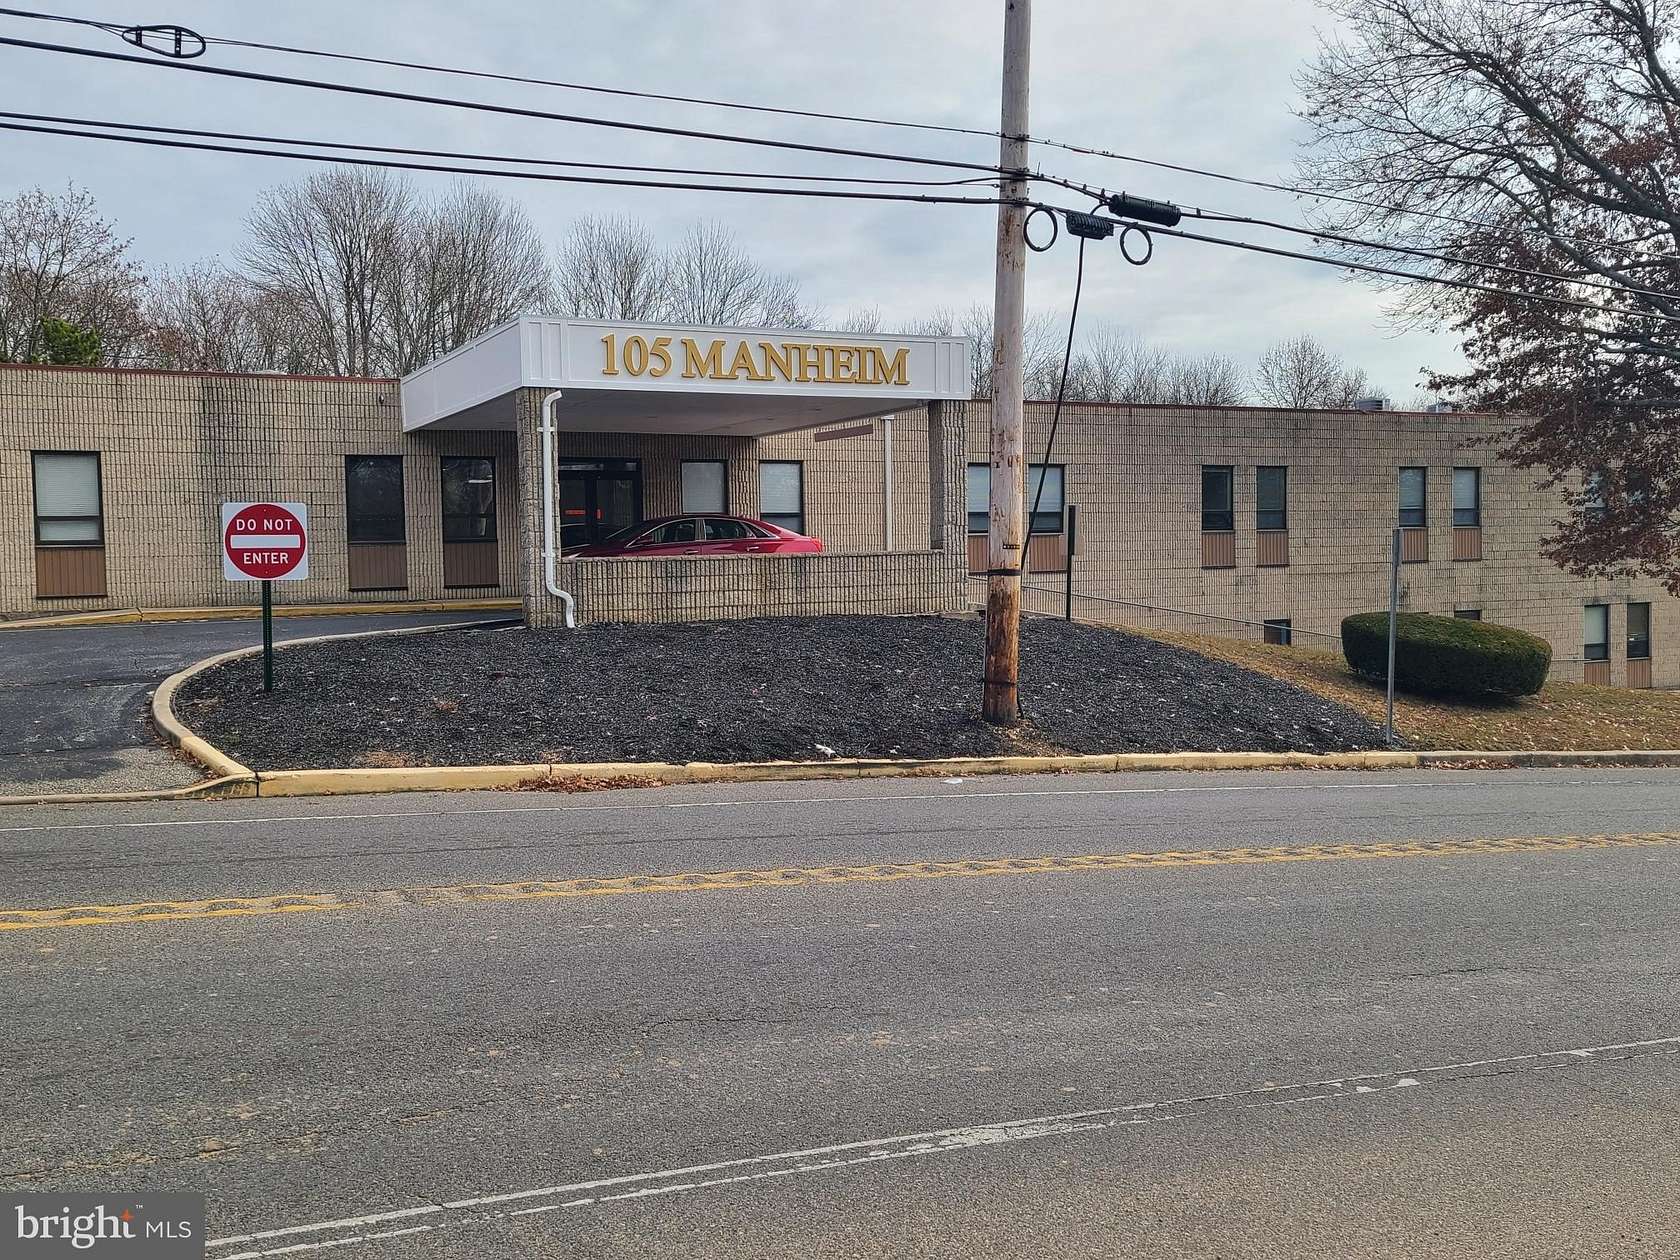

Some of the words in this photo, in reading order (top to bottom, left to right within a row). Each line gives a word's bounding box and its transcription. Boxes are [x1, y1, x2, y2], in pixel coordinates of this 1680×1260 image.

[601, 333, 673, 377] 105
[681, 338, 911, 386] MANHEIM
[236, 519, 257, 531] DO
[263, 519, 293, 531] NOT
[243, 552, 289, 564] ENTER
